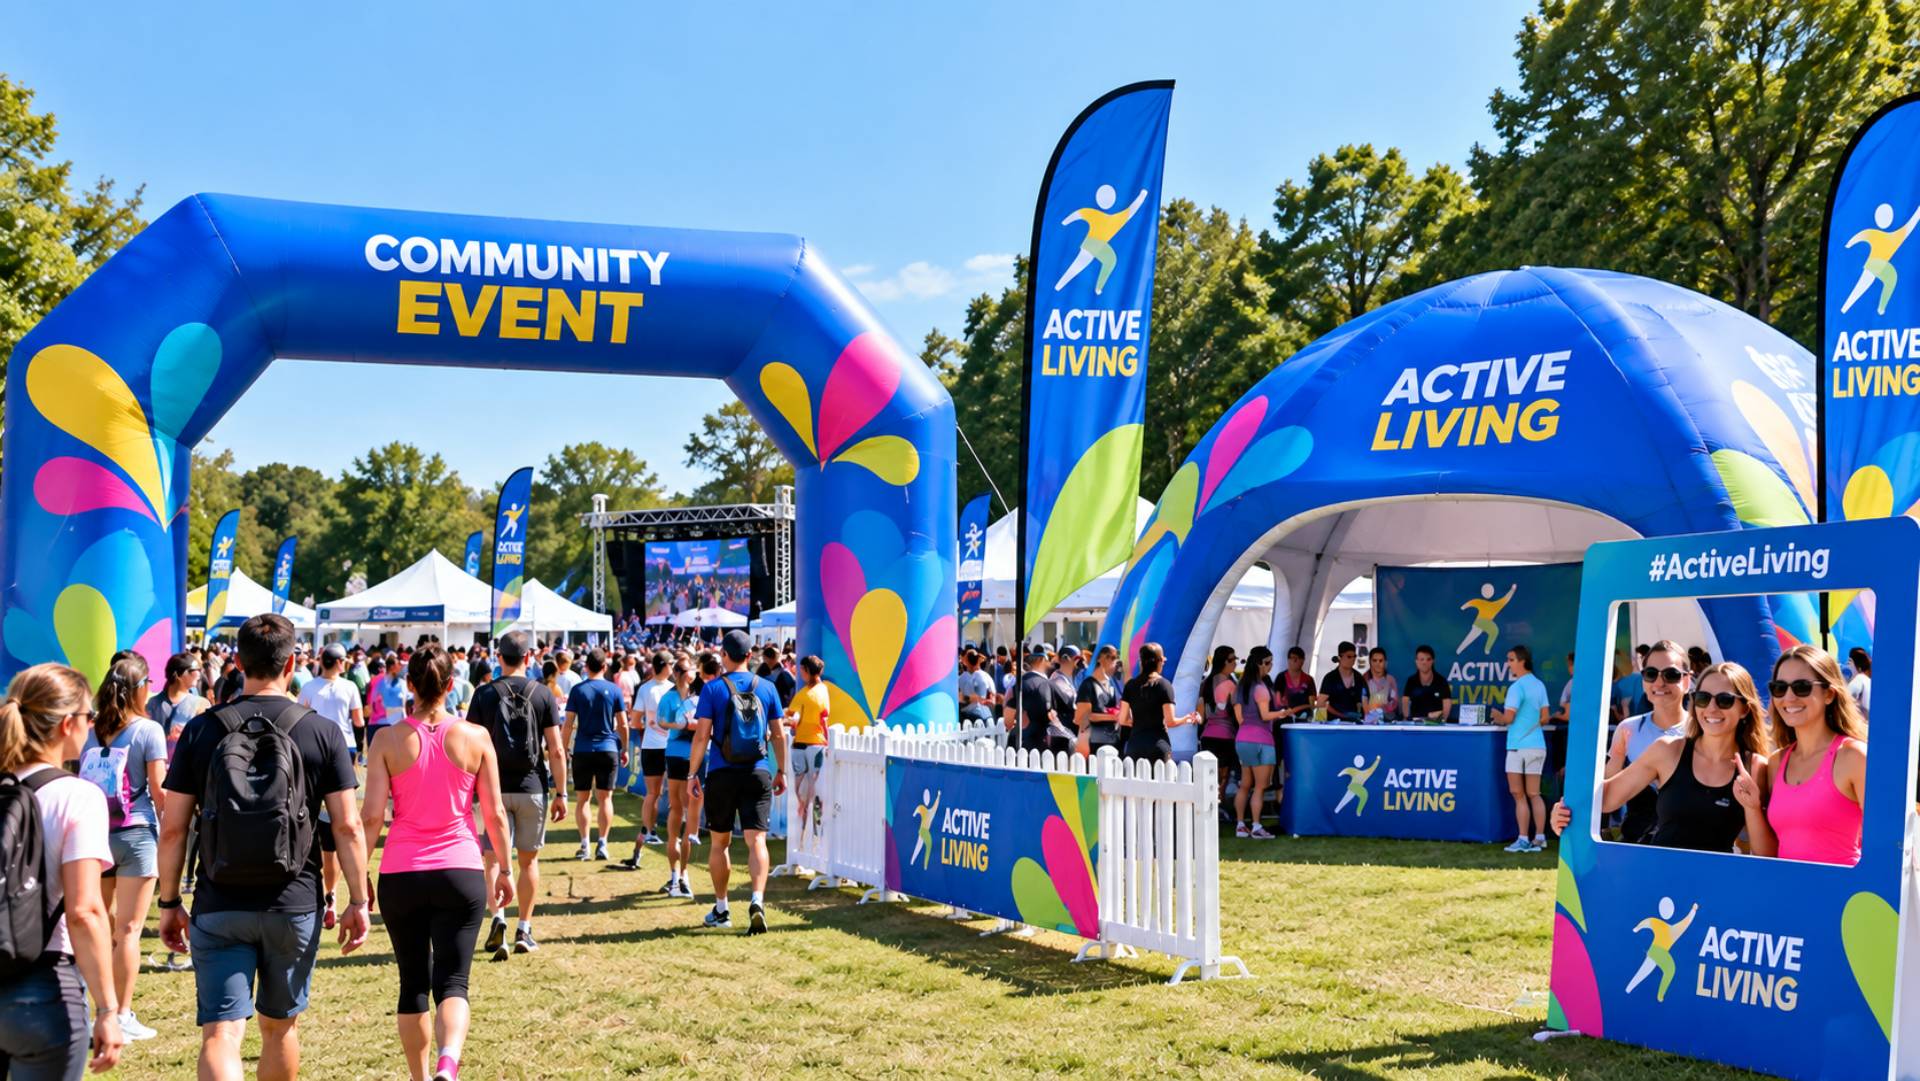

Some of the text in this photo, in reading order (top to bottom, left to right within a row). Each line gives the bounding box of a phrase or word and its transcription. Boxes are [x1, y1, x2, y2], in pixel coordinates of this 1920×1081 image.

[364, 234, 670, 286] COMMUNITY
[397, 280, 644, 344] EVENT
[1042, 308, 1142, 340] ACTIVE
[1042, 344, 1138, 377] LIVING
[1832, 327, 1920, 362] ACTIVE
[1381, 350, 1572, 406] ACTIVE
[1832, 363, 1920, 398] LIVING
[1370, 398, 1560, 451] LIVING
[1649, 542, 1830, 582] #ActiveLiving
[1449, 684, 1507, 705] IVIN
[1383, 768, 1458, 789] ACTIVE
[1383, 791, 1456, 813] LIVING
[941, 807, 990, 840] ACTIVE
[941, 837, 988, 872] LIVING
[1698, 926, 1804, 972] ACTIVE
[1695, 963, 1798, 1011] LIVING
